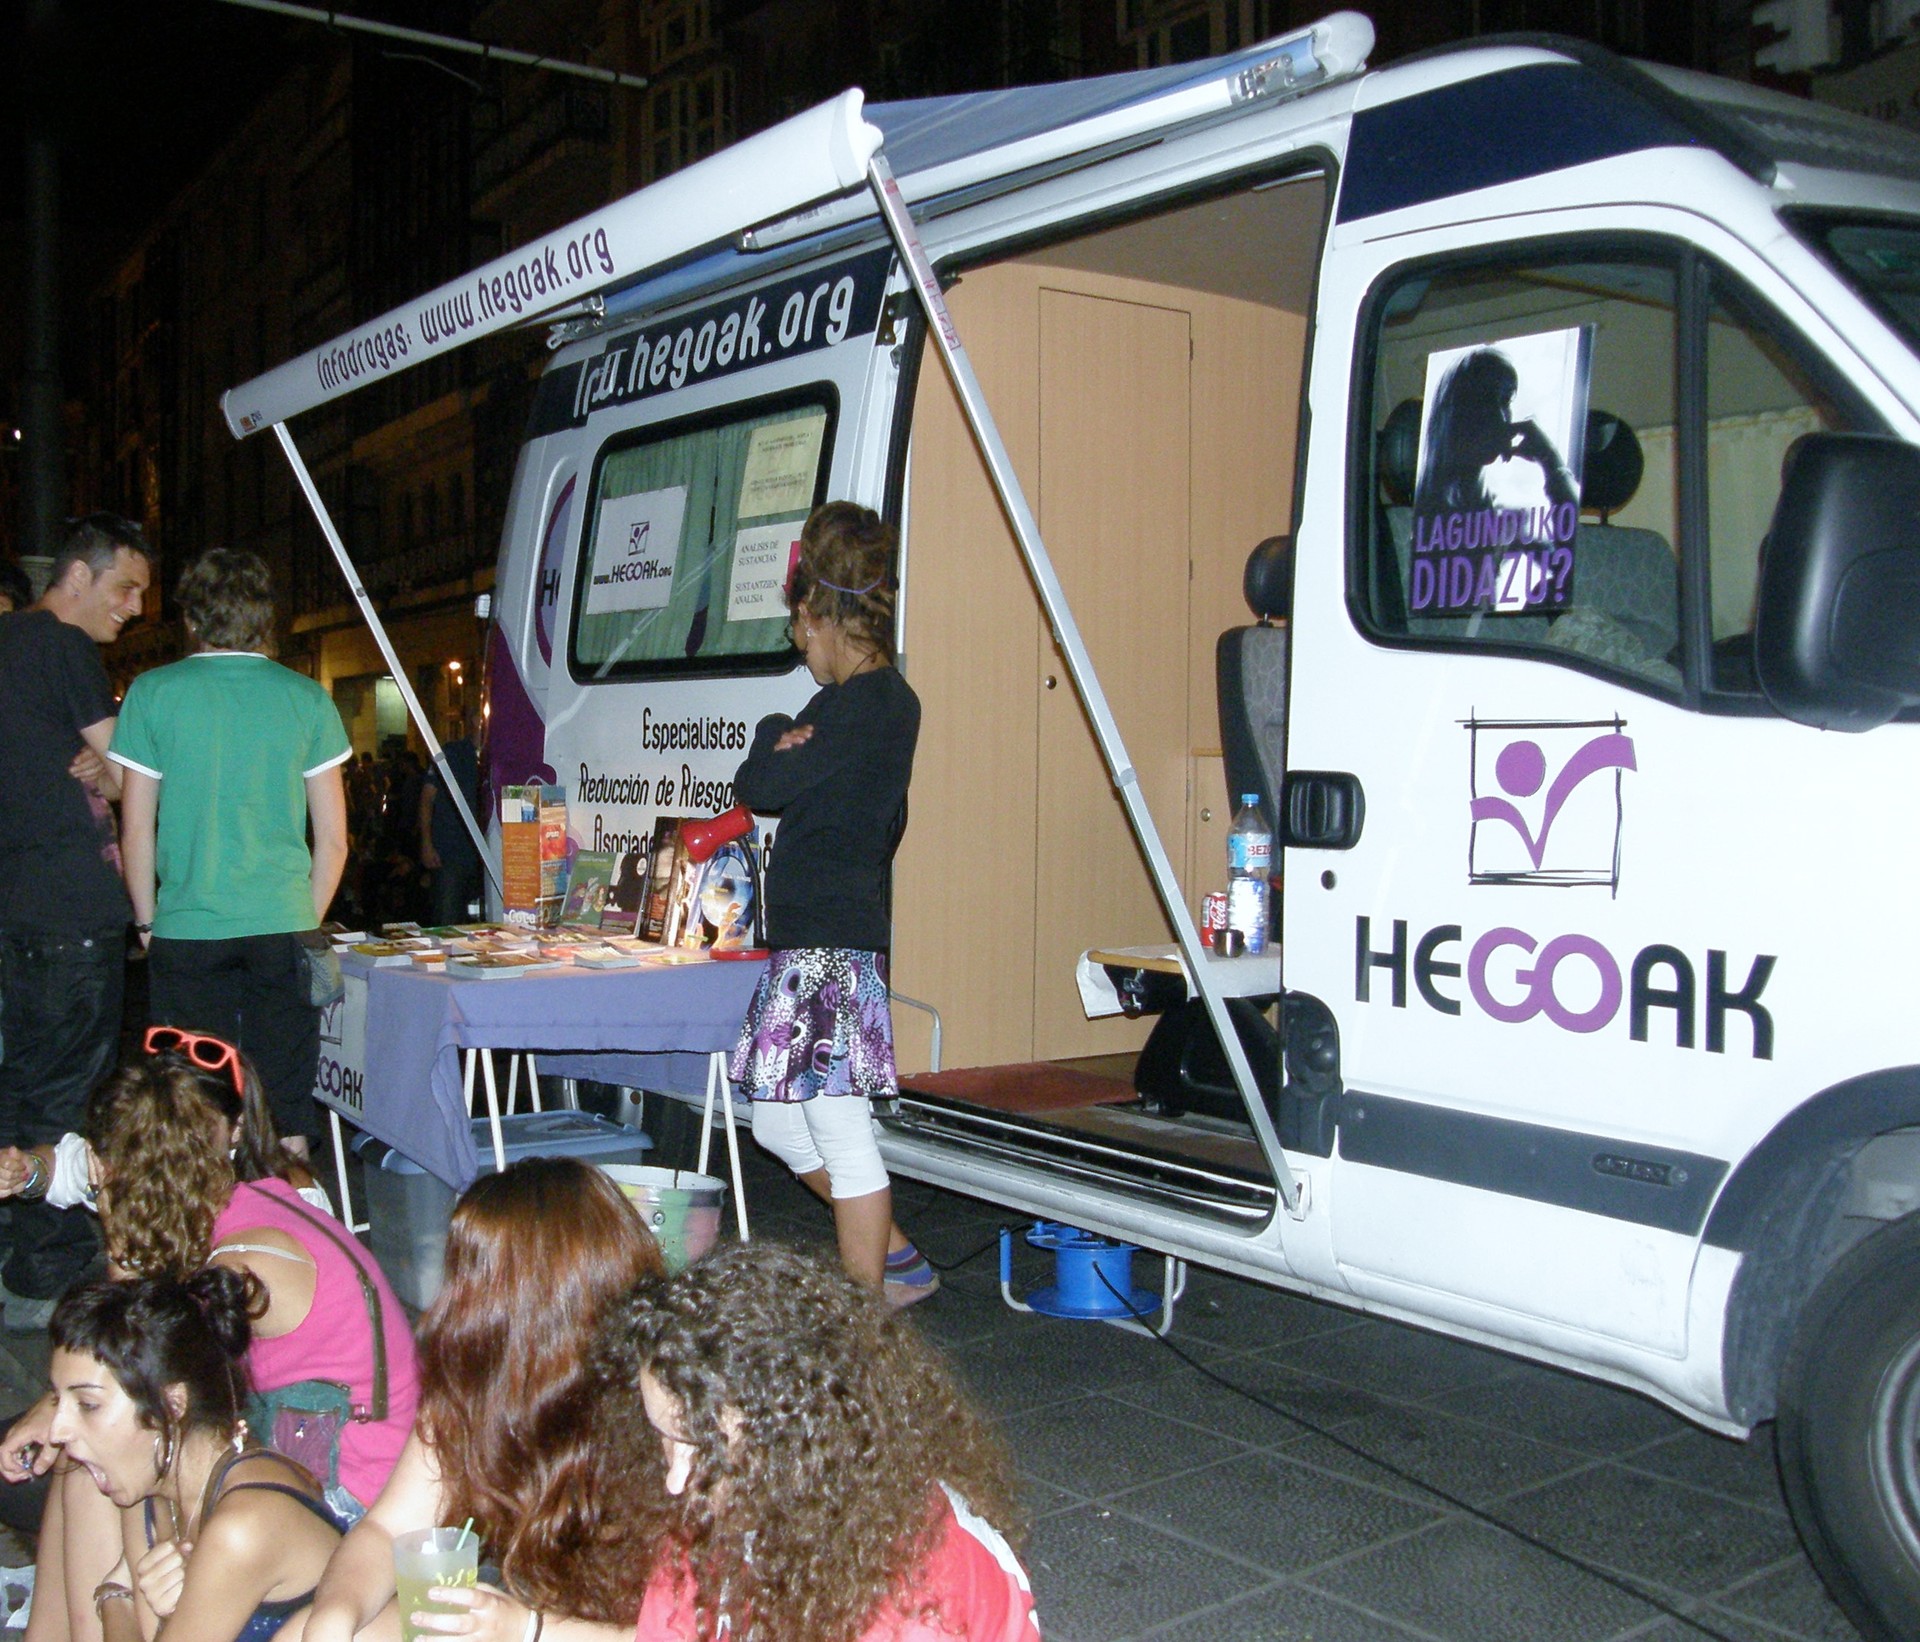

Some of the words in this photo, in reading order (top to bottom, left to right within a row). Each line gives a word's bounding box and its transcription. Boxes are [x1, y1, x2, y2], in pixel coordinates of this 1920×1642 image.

[419, 227, 615, 346] www.hegoak.org
[1415, 501, 1576, 553] LAGUNDUKO
[738, 553, 777, 567] SUSTANCIAS
[1412, 547, 1573, 610] DIDAZU?
[642, 706, 747, 755] Especialistas
[578, 762, 650, 806] Reducción
[655, 774, 675, 807] de
[678, 763, 739, 815] Riesgo
[1355, 915, 1779, 1062] HEGOAK
